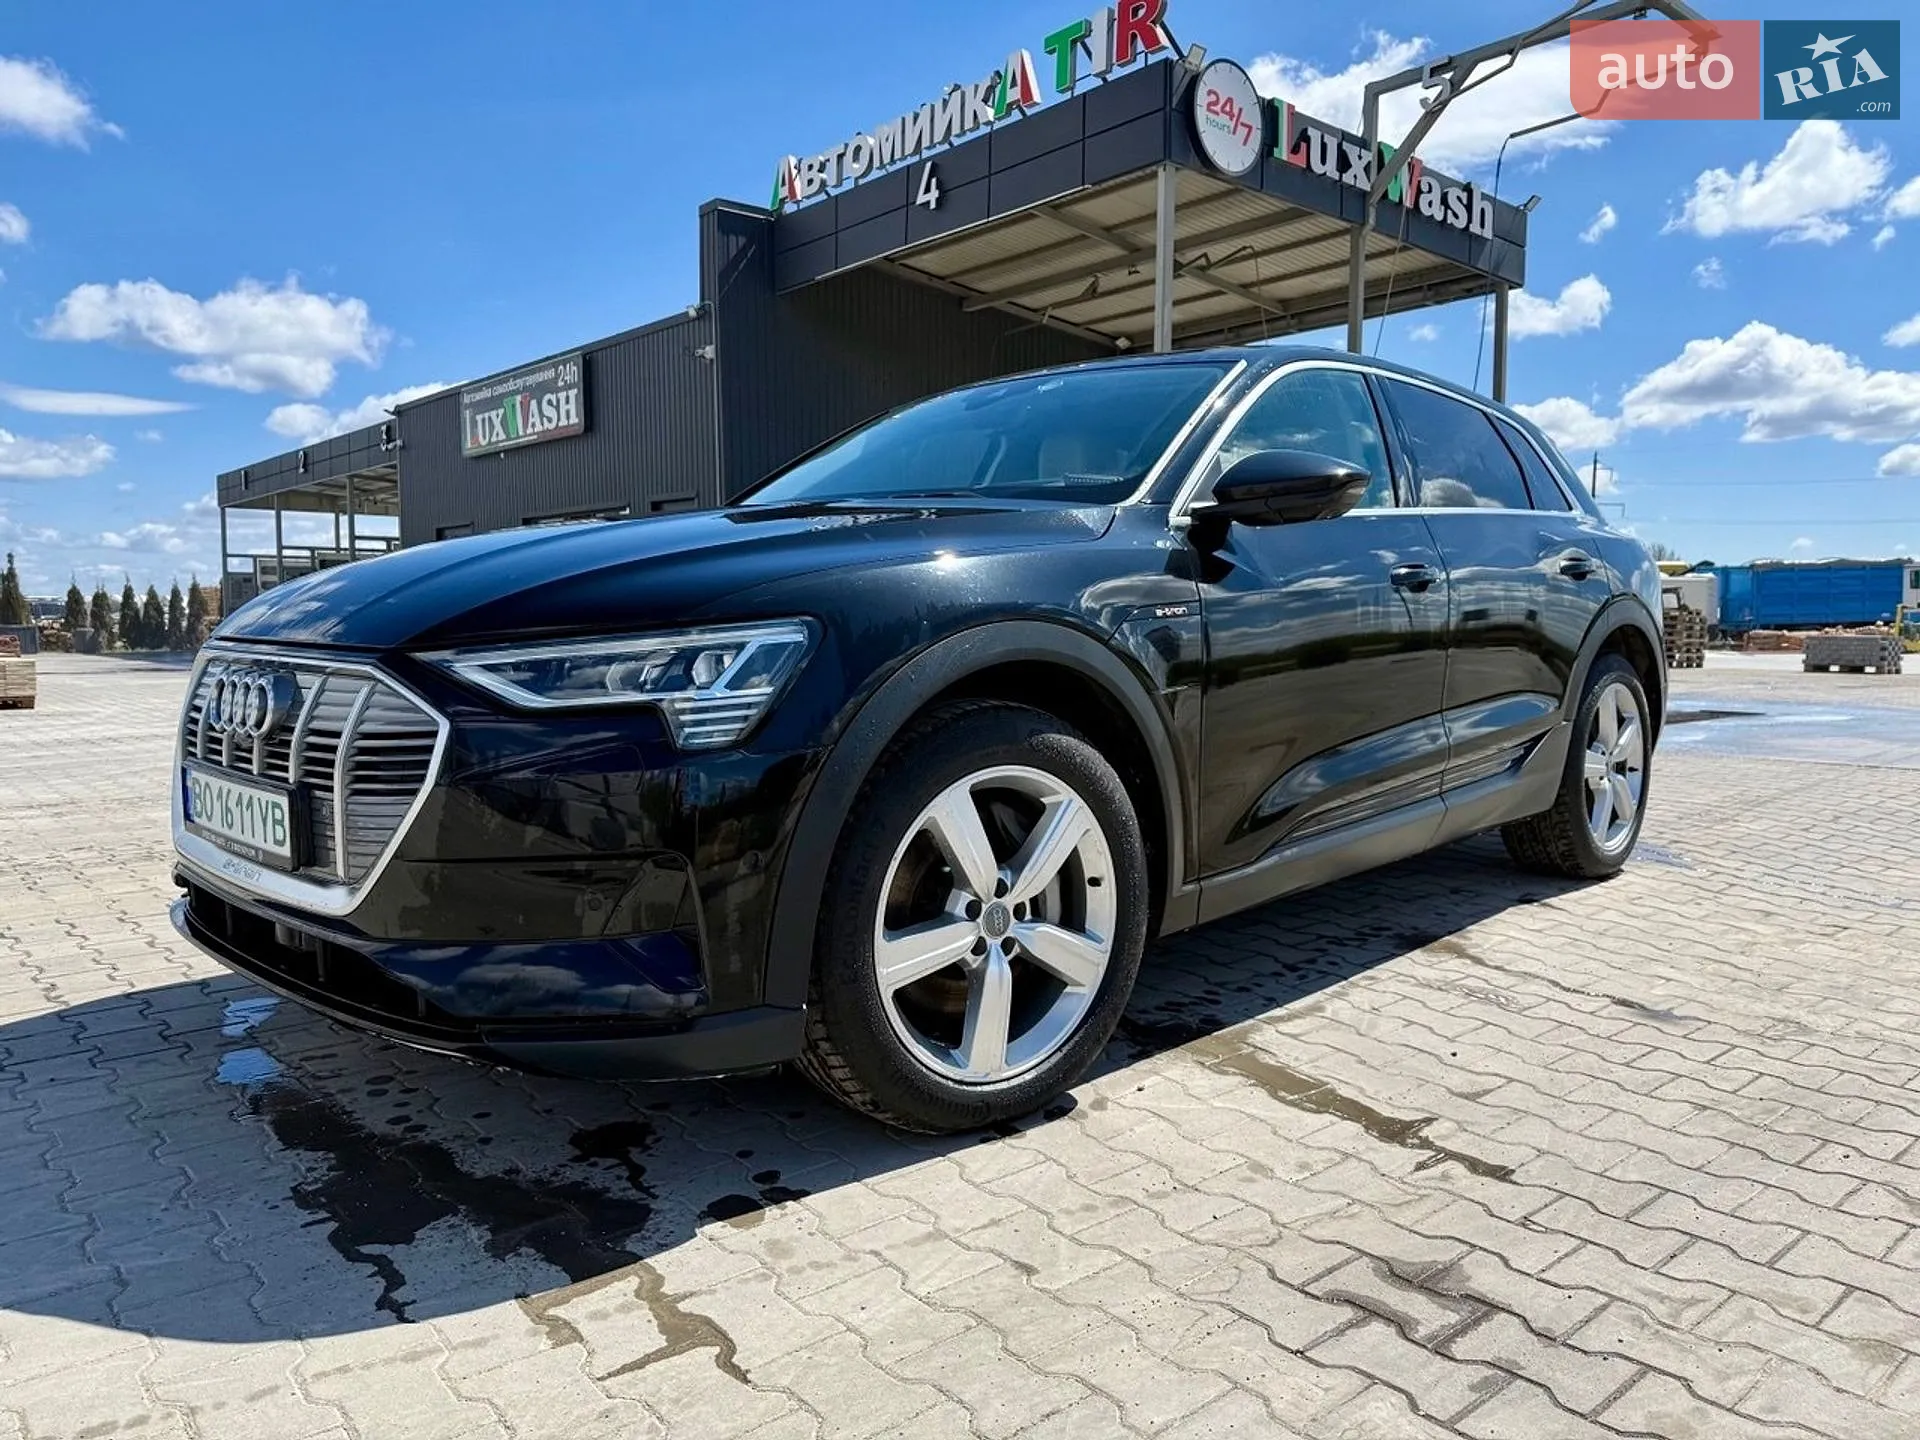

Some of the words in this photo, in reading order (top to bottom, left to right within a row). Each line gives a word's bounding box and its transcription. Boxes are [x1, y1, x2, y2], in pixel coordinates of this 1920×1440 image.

[1043, 0, 1168, 93] TIR
[1419, 56, 1452, 111] 5
[1205, 115, 1233, 136] hours
[1206, 88, 1253, 147] 24/7
[915, 161, 940, 210] 4
[557, 360, 578, 388] 24h
